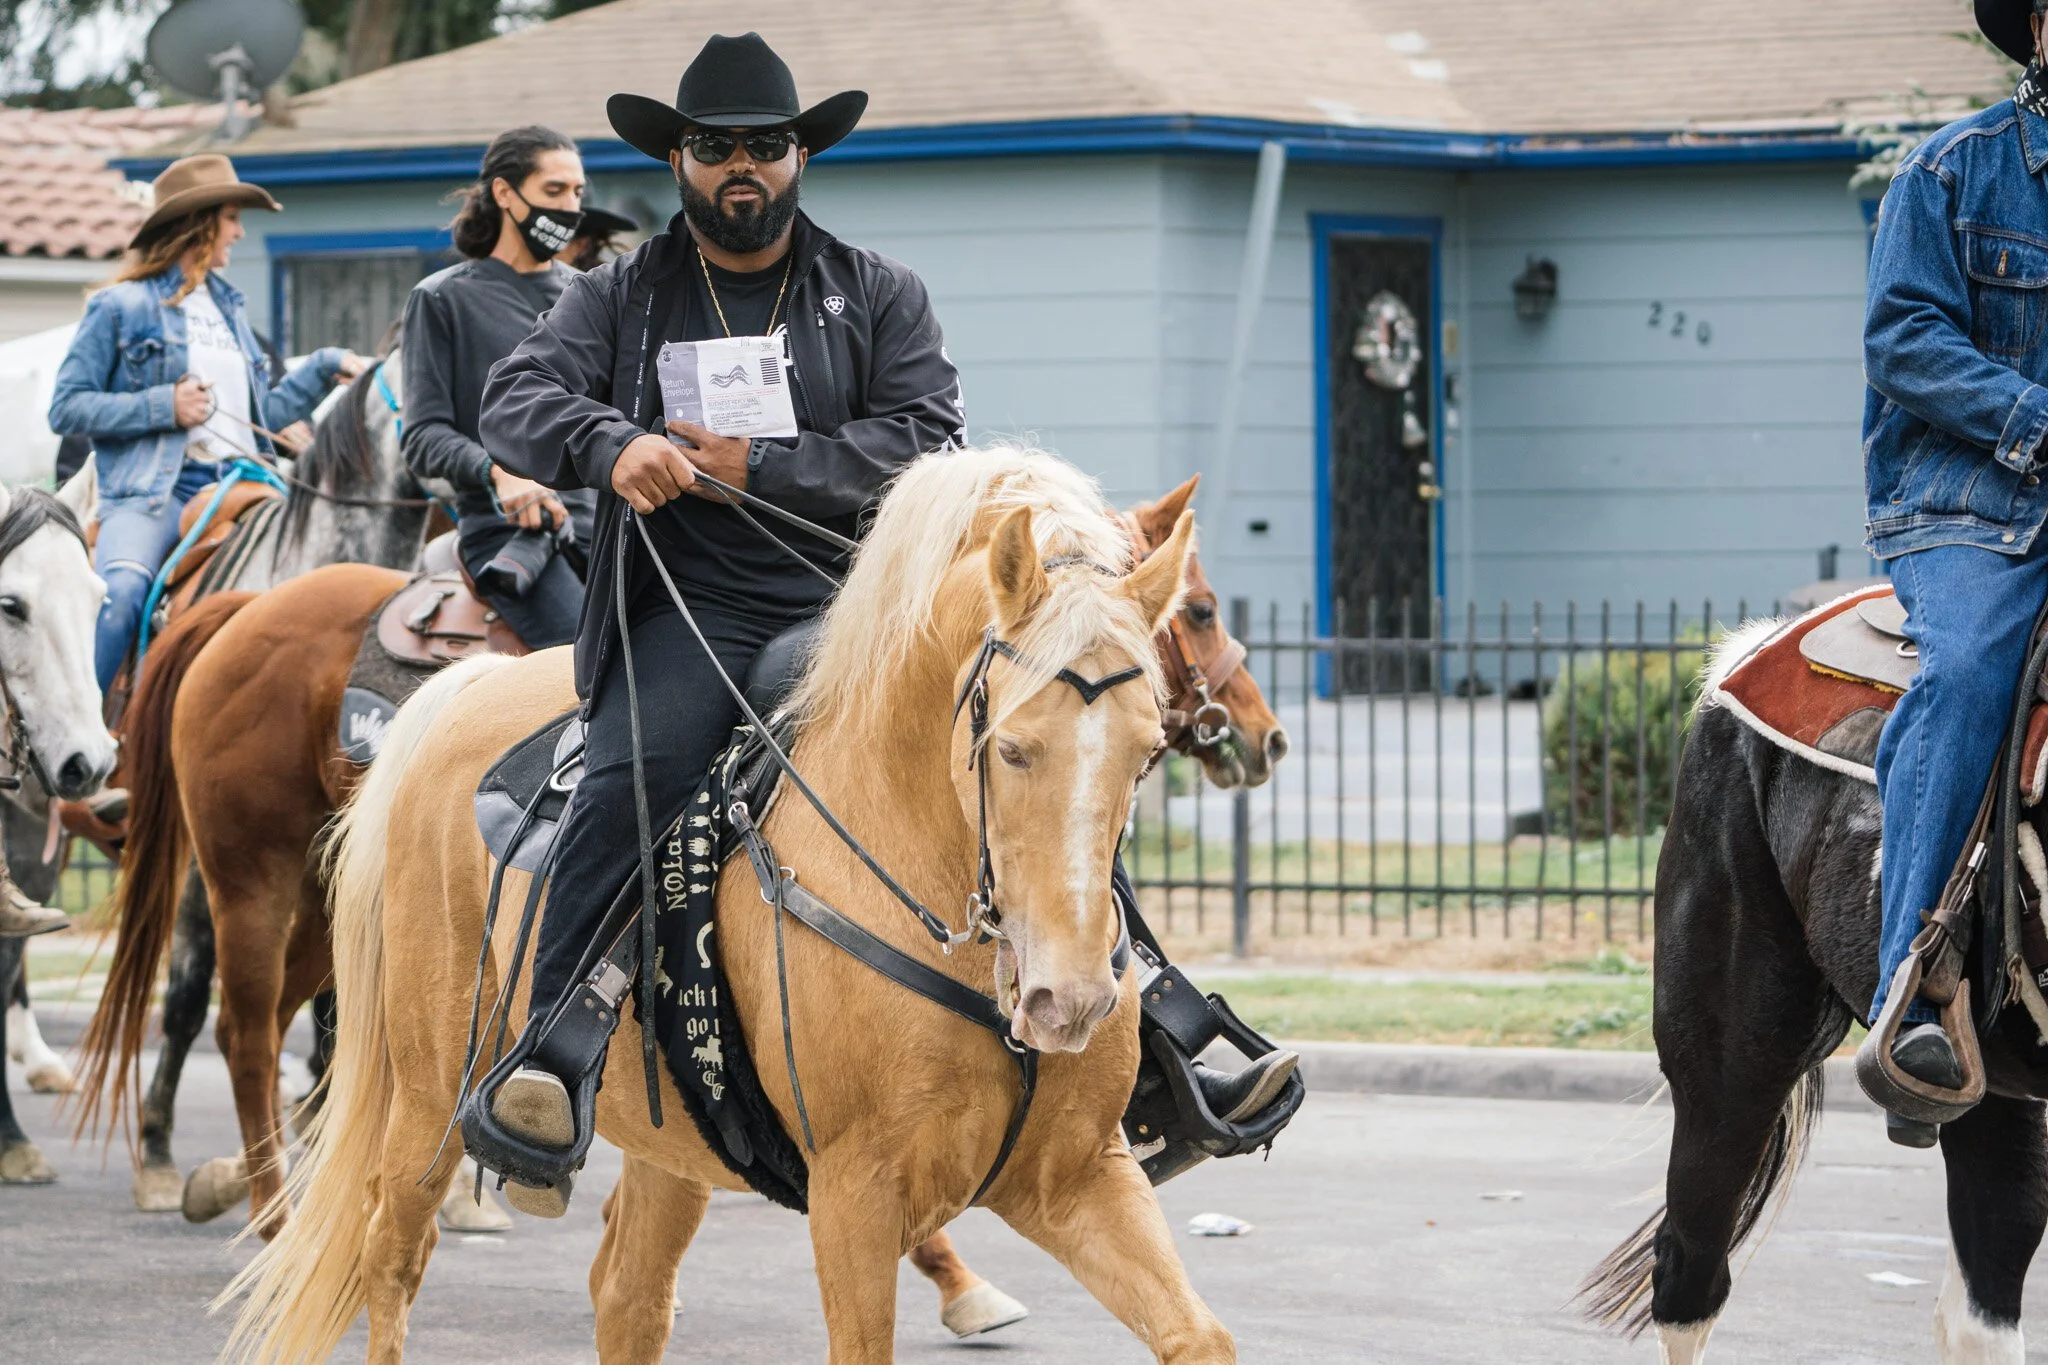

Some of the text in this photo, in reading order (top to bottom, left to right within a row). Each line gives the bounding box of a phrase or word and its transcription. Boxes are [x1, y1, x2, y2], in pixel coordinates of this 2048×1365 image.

[1647, 300, 1711, 347] 220
[661, 379, 685, 389] Return
[663, 387, 694, 398] Envelope
[686, 1017, 709, 1041] go
